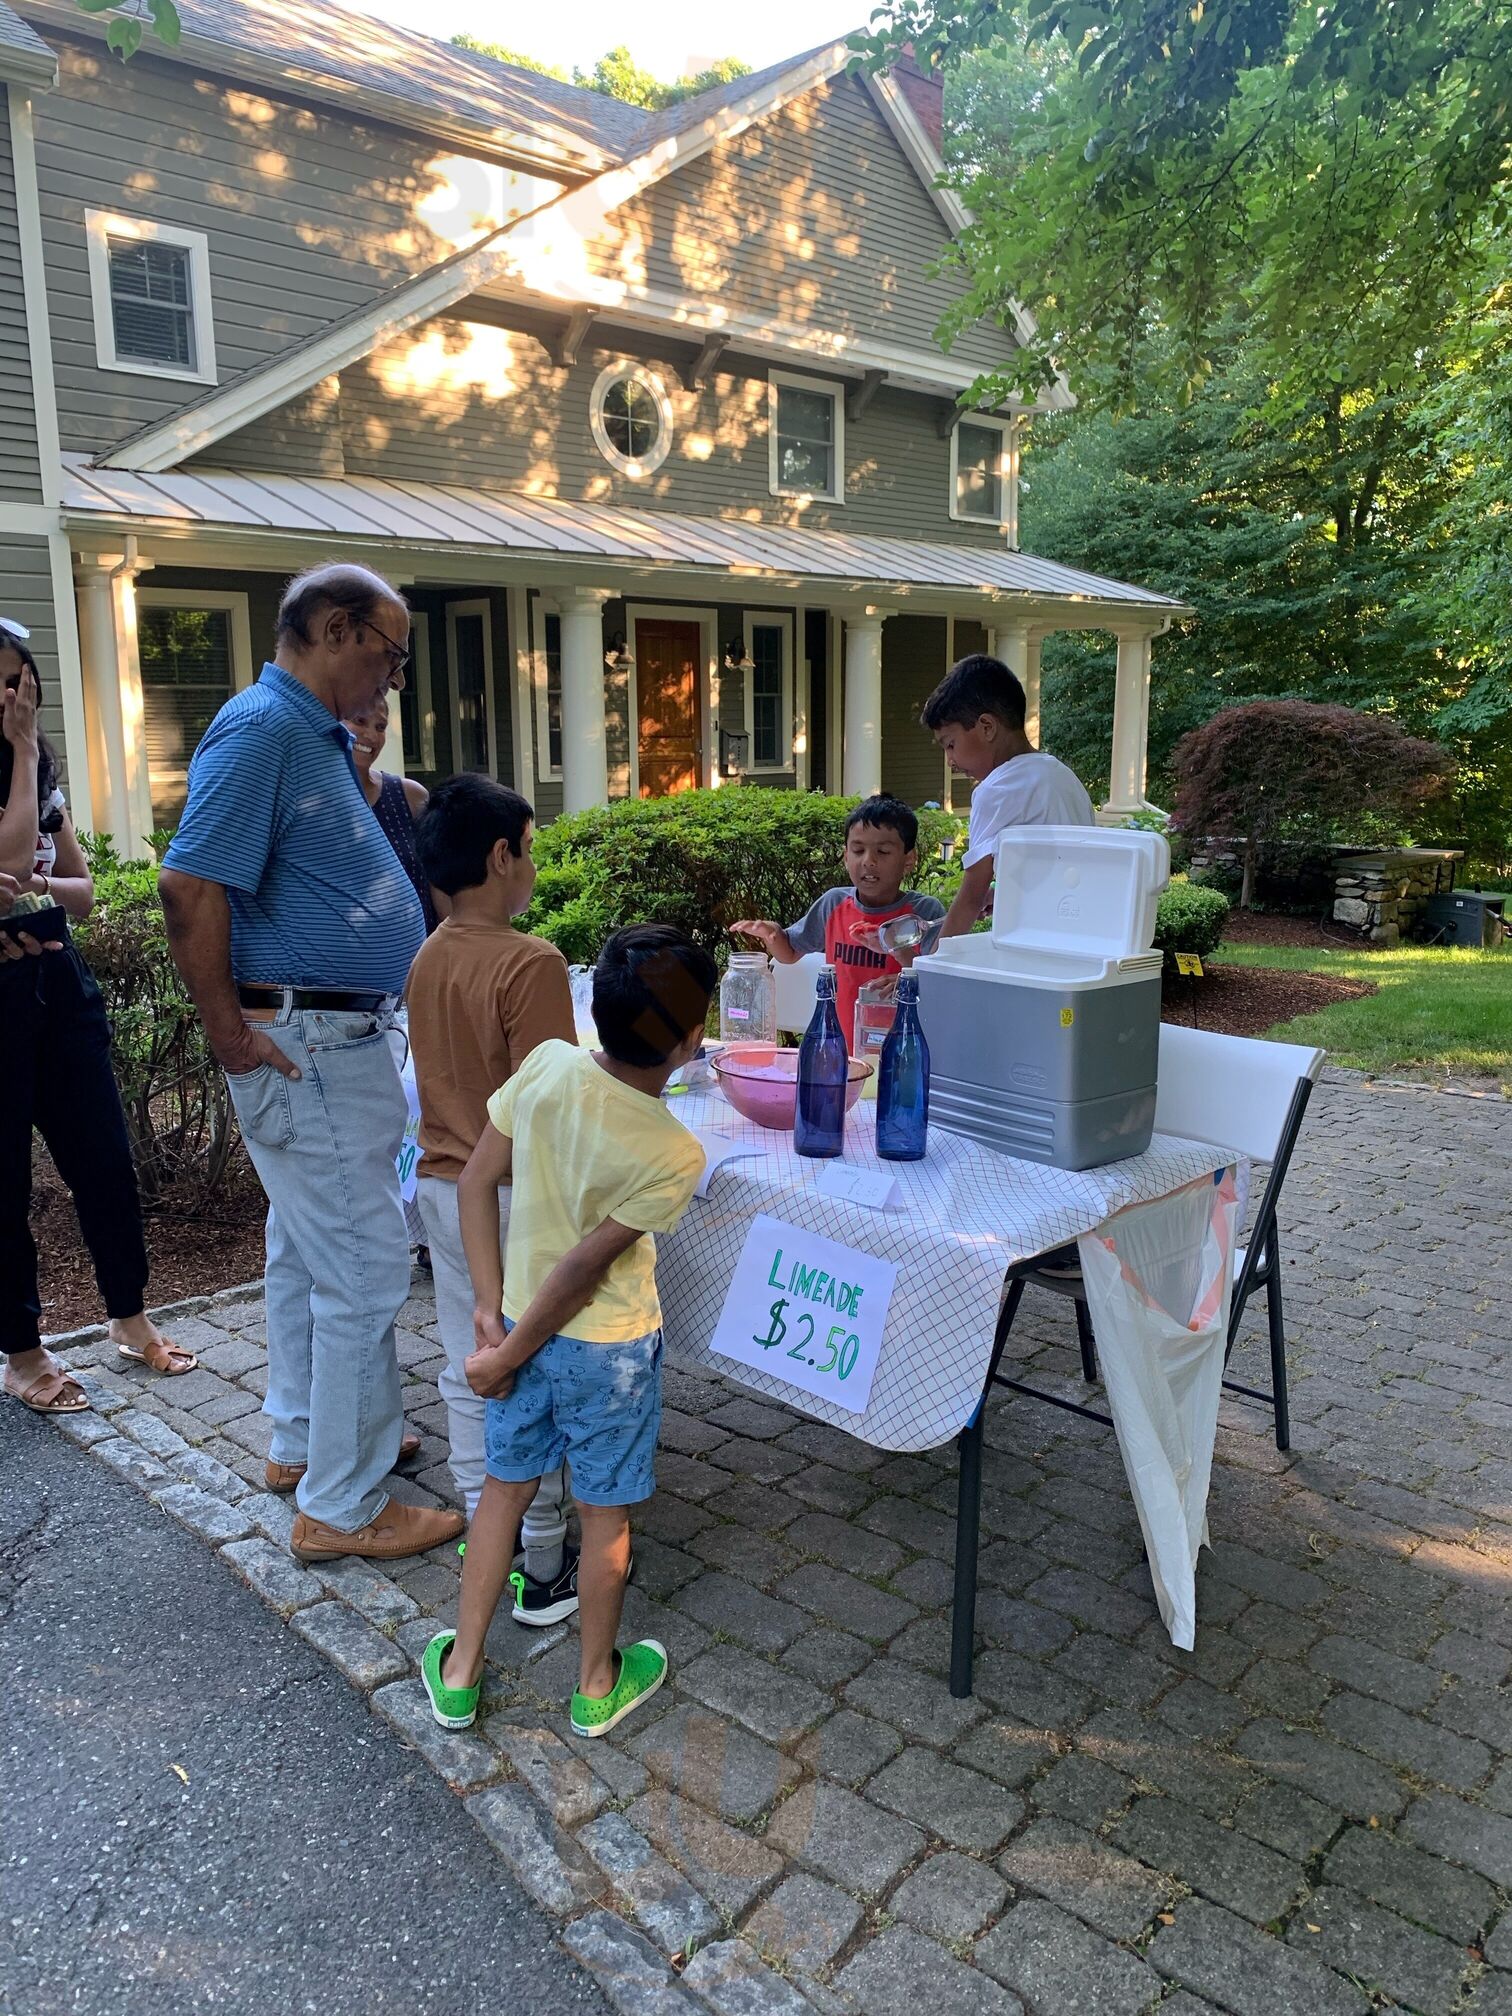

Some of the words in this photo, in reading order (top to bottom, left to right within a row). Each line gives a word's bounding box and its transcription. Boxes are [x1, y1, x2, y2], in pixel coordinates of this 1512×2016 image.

[834, 941, 887, 969] PUMA
[768, 1248, 865, 1320] LIMEADE
[752, 1298, 860, 1381] $2.50
